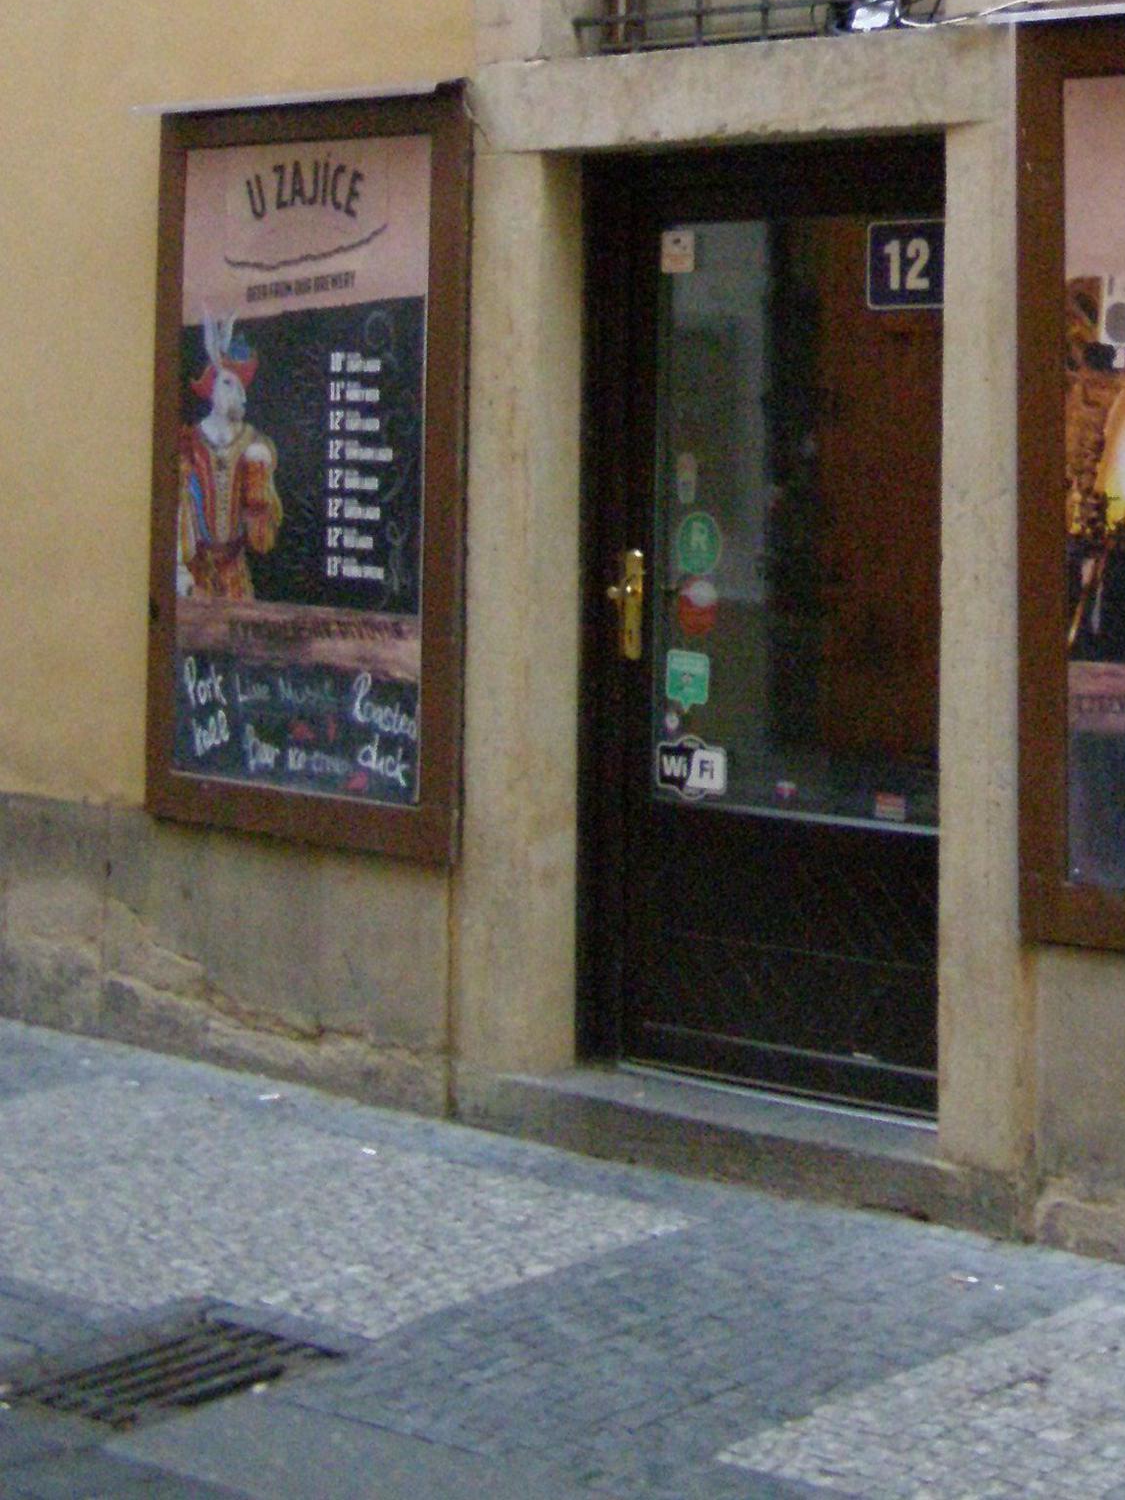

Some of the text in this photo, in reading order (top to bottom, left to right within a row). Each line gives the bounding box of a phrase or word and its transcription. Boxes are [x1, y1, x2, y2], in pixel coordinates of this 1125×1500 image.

[246, 152, 365, 220] U ZAJÍCE
[884, 237, 930, 291] 12
[184, 655, 228, 709] Pork
[357, 733, 410, 789] duck
